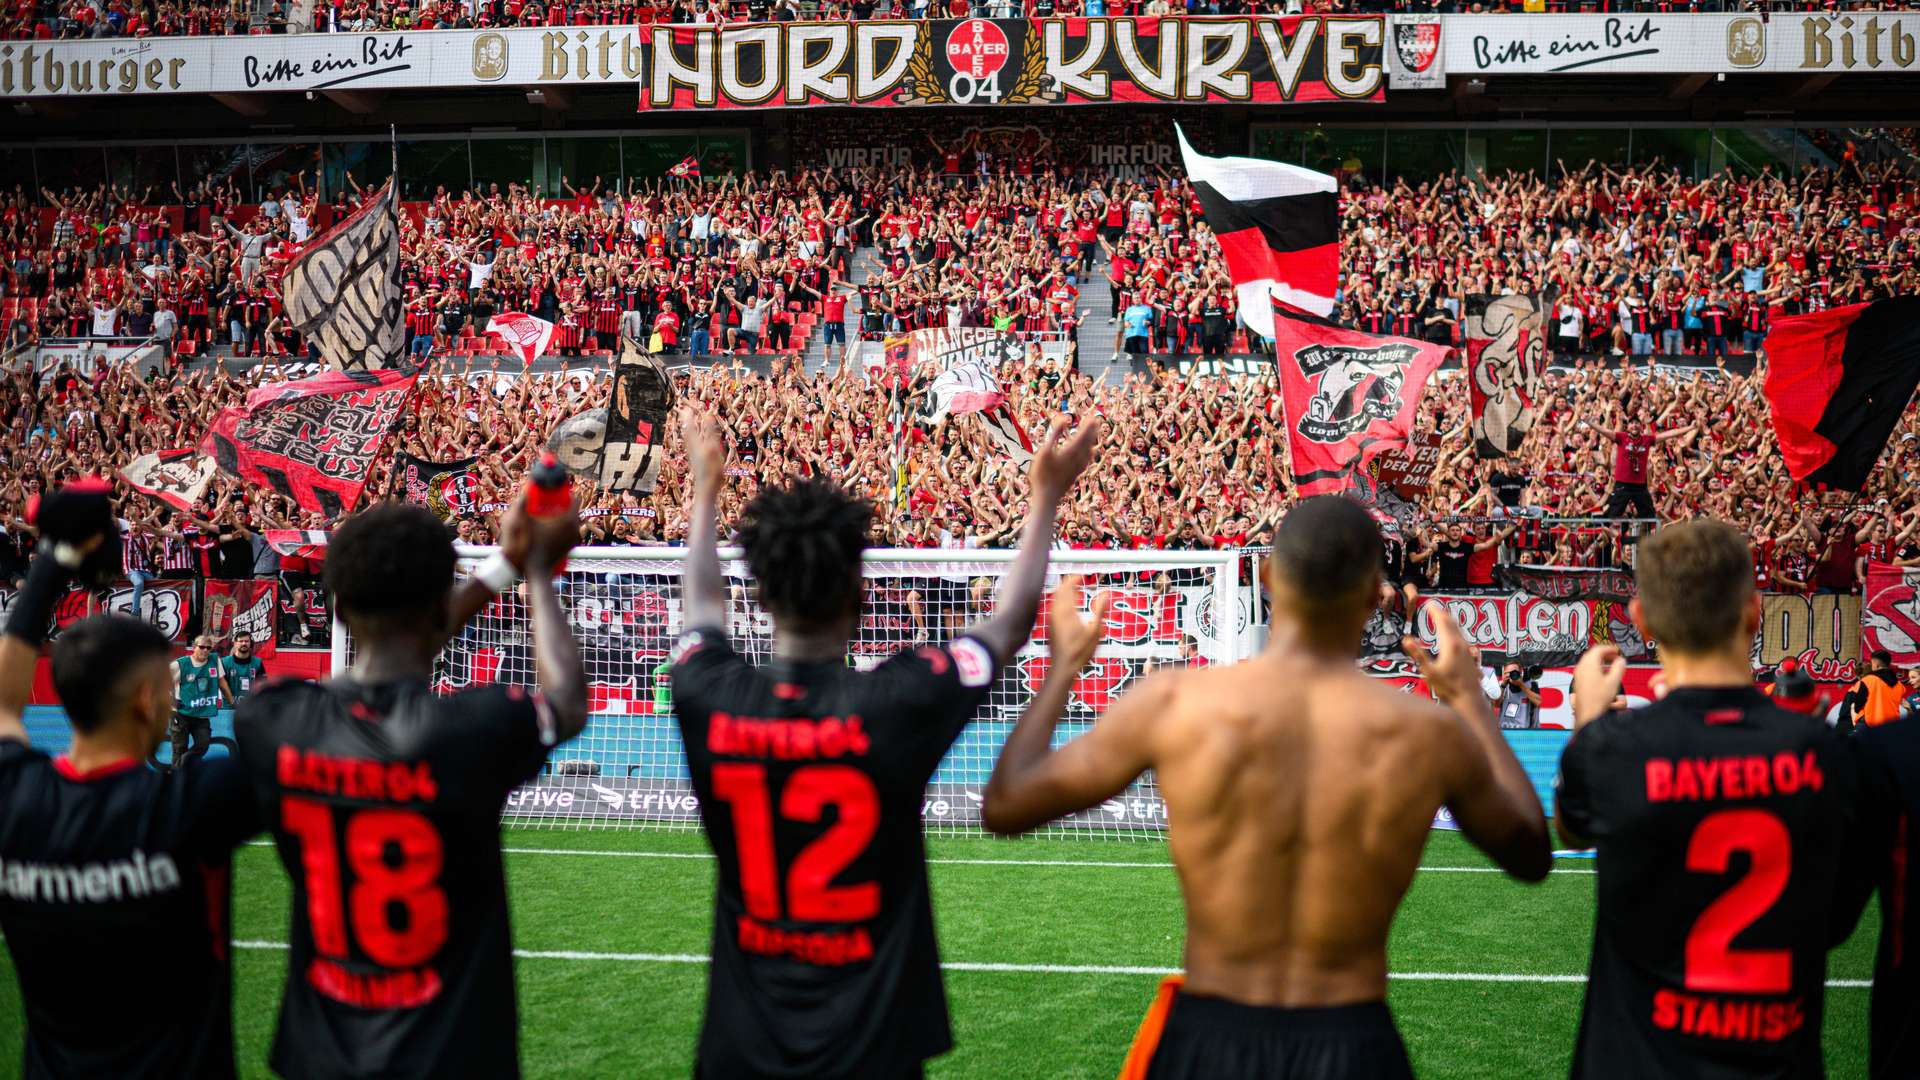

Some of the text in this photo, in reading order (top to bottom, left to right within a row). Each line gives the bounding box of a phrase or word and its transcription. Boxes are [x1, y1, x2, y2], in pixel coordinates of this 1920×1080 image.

[244, 36, 413, 88] Bitte ein Bit
[949, 43, 1006, 55] BAYER
[1042, 18, 1384, 99] KURVE
[1473, 17, 1661, 69] Bitte ein Bit
[651, 23, 919, 105] NORD
[949, 71, 1003, 105] 04
[825, 147, 868, 168] WIR
[1089, 141, 1173, 165] IHR FÜR
[1382, 459, 1433, 474] DER IST
[232, 588, 273, 628] FREIHEIT
[253, 613, 268, 632] DIE
[190, 696, 218, 709] HOST
[628, 789, 699, 812] trive
[709, 763, 882, 922] 12
[0, 848, 181, 903] armenia
[280, 794, 450, 968] 18
[1685, 808, 1793, 994] 2
